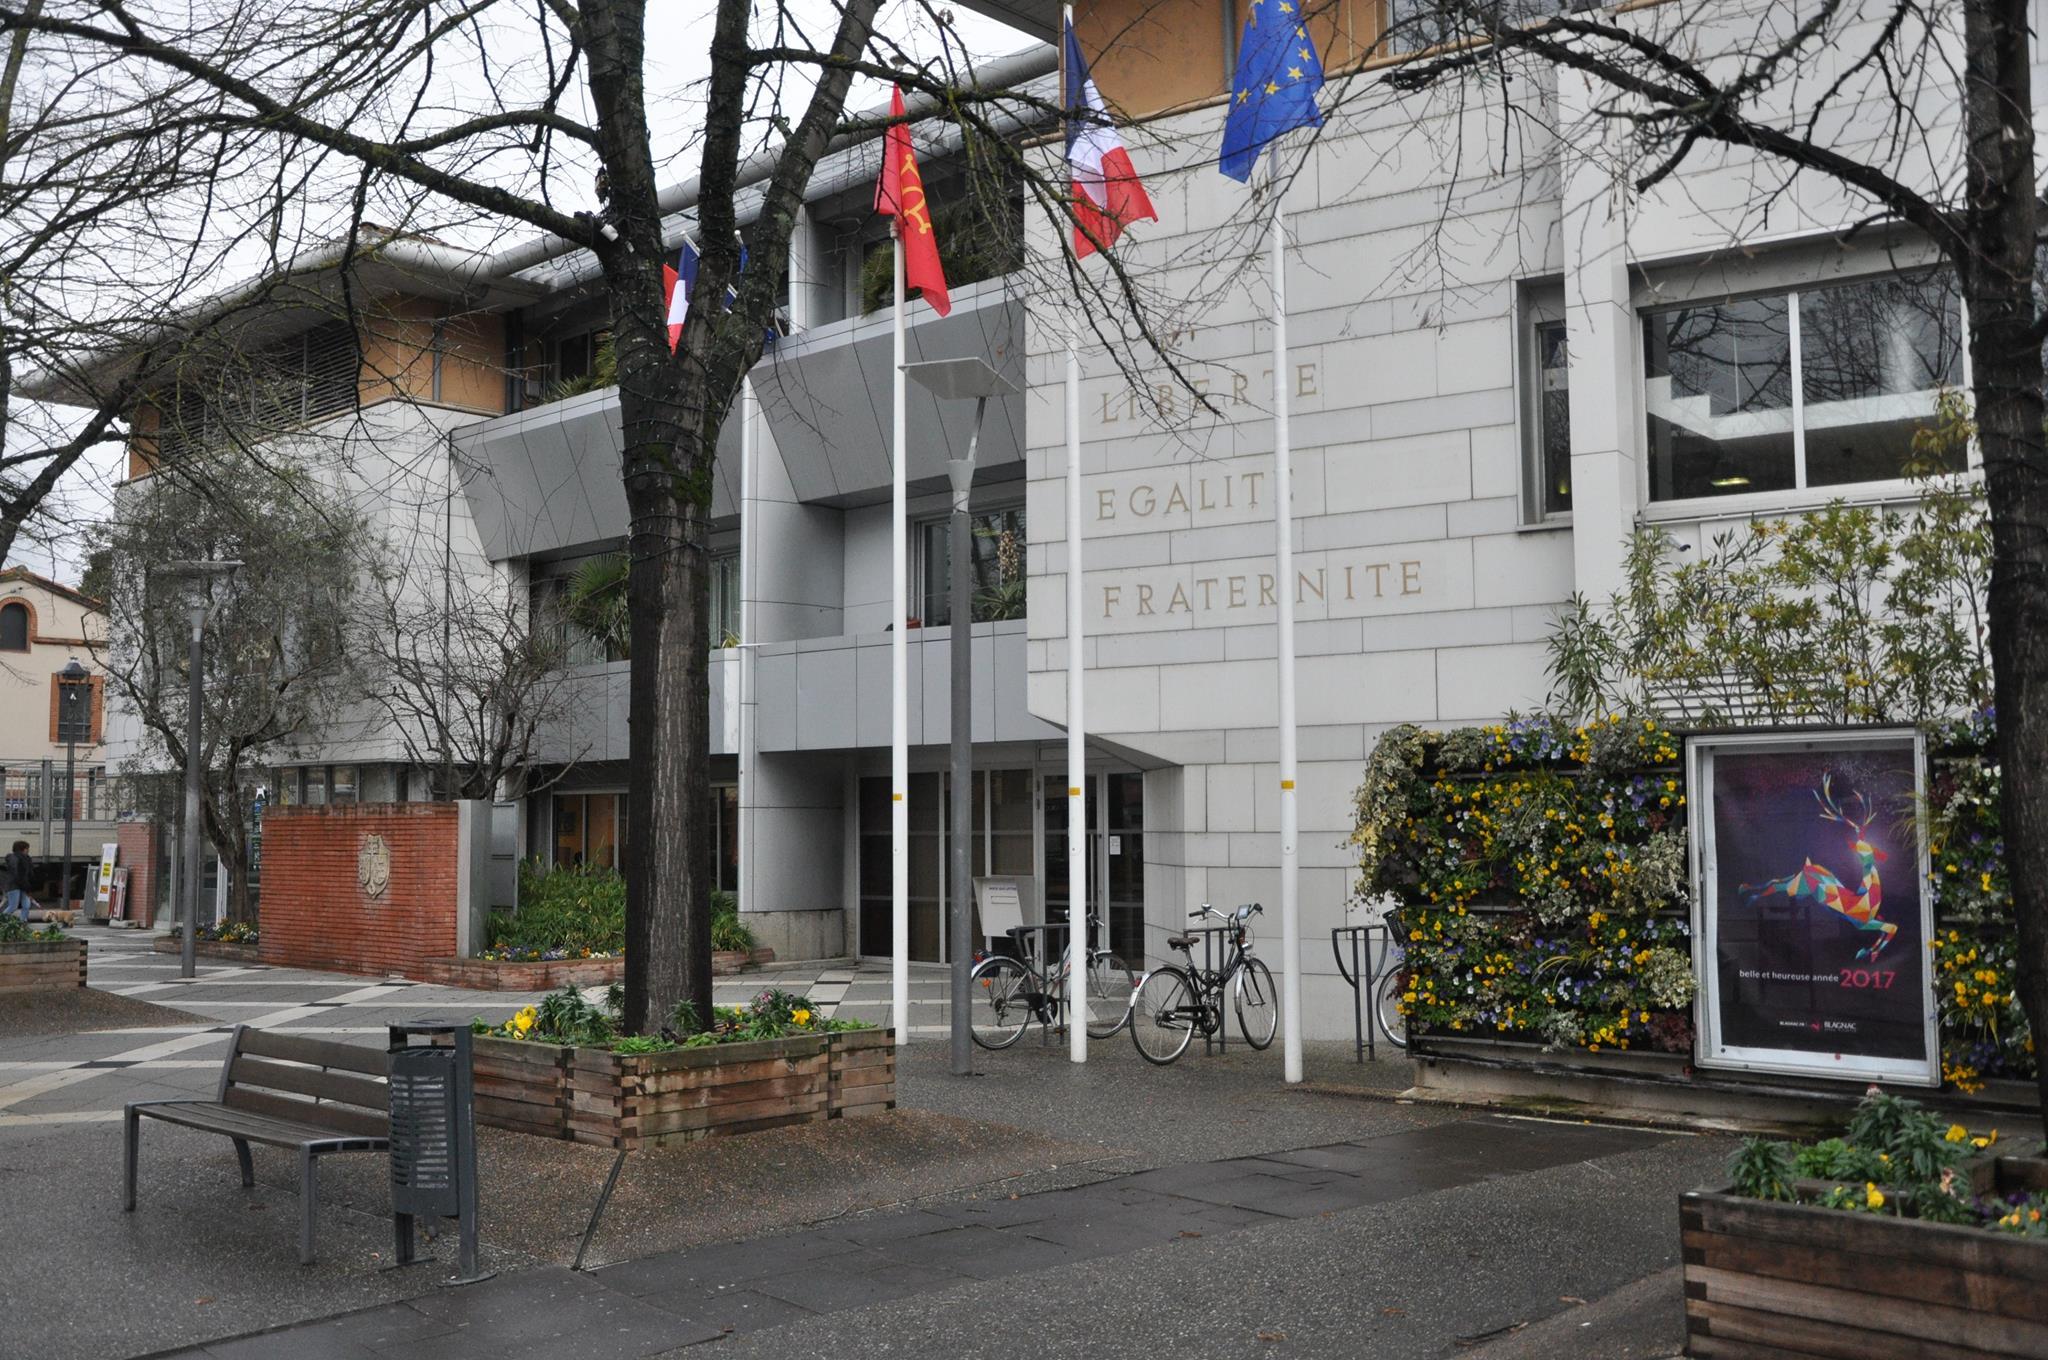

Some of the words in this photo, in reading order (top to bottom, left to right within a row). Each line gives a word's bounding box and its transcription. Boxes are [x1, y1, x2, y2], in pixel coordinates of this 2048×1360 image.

[1095, 468, 1295, 521] EGALIT
[1102, 560, 1422, 618] FRATERNITE
[1739, 969, 1760, 979] belle
[1761, 971, 1770, 979] et
[1772, 971, 1810, 981] heureuse
[1812, 973, 1839, 982] année
[1840, 968, 1896, 989] 2017
[1824, 1021, 1857, 1029] BLAGNAC
